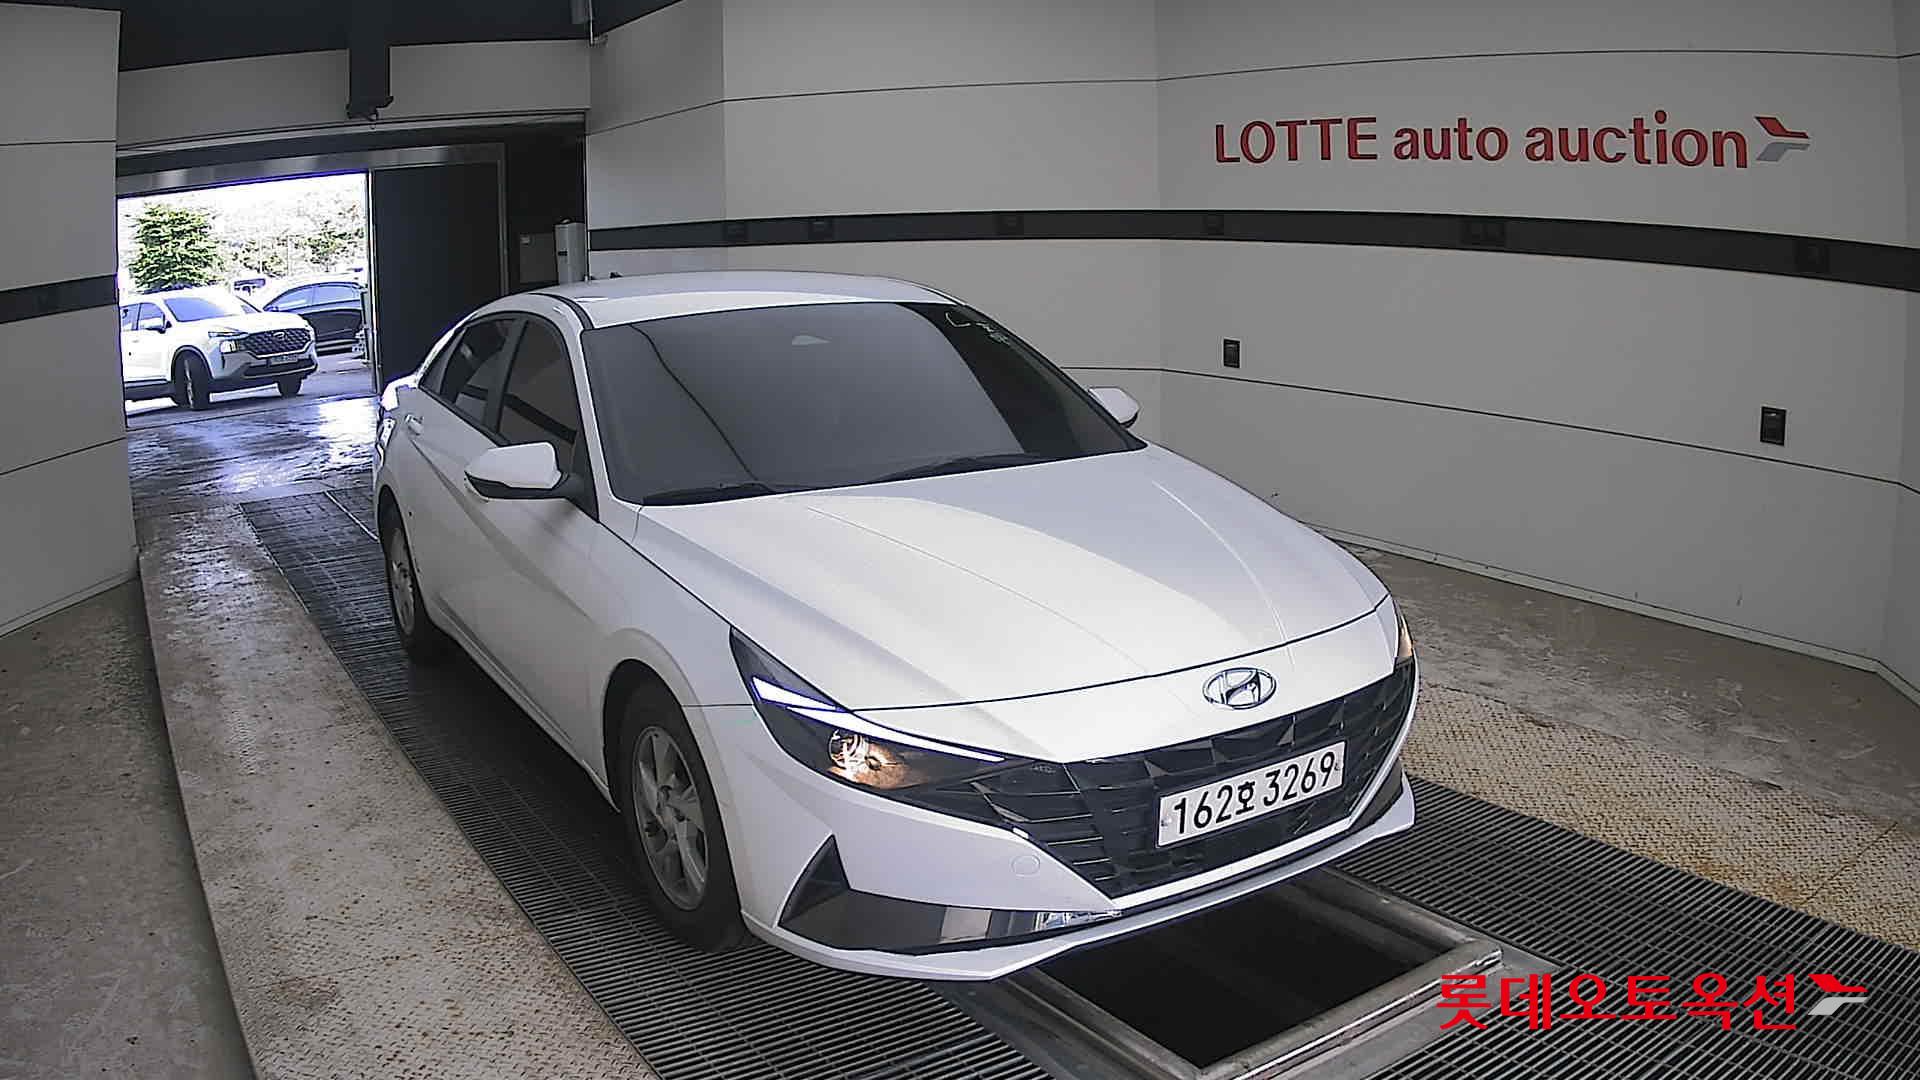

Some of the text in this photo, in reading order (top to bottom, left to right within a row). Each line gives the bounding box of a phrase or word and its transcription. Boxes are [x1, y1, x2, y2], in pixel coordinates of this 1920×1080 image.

[1215, 109, 1748, 168] LOTTE auto auction
